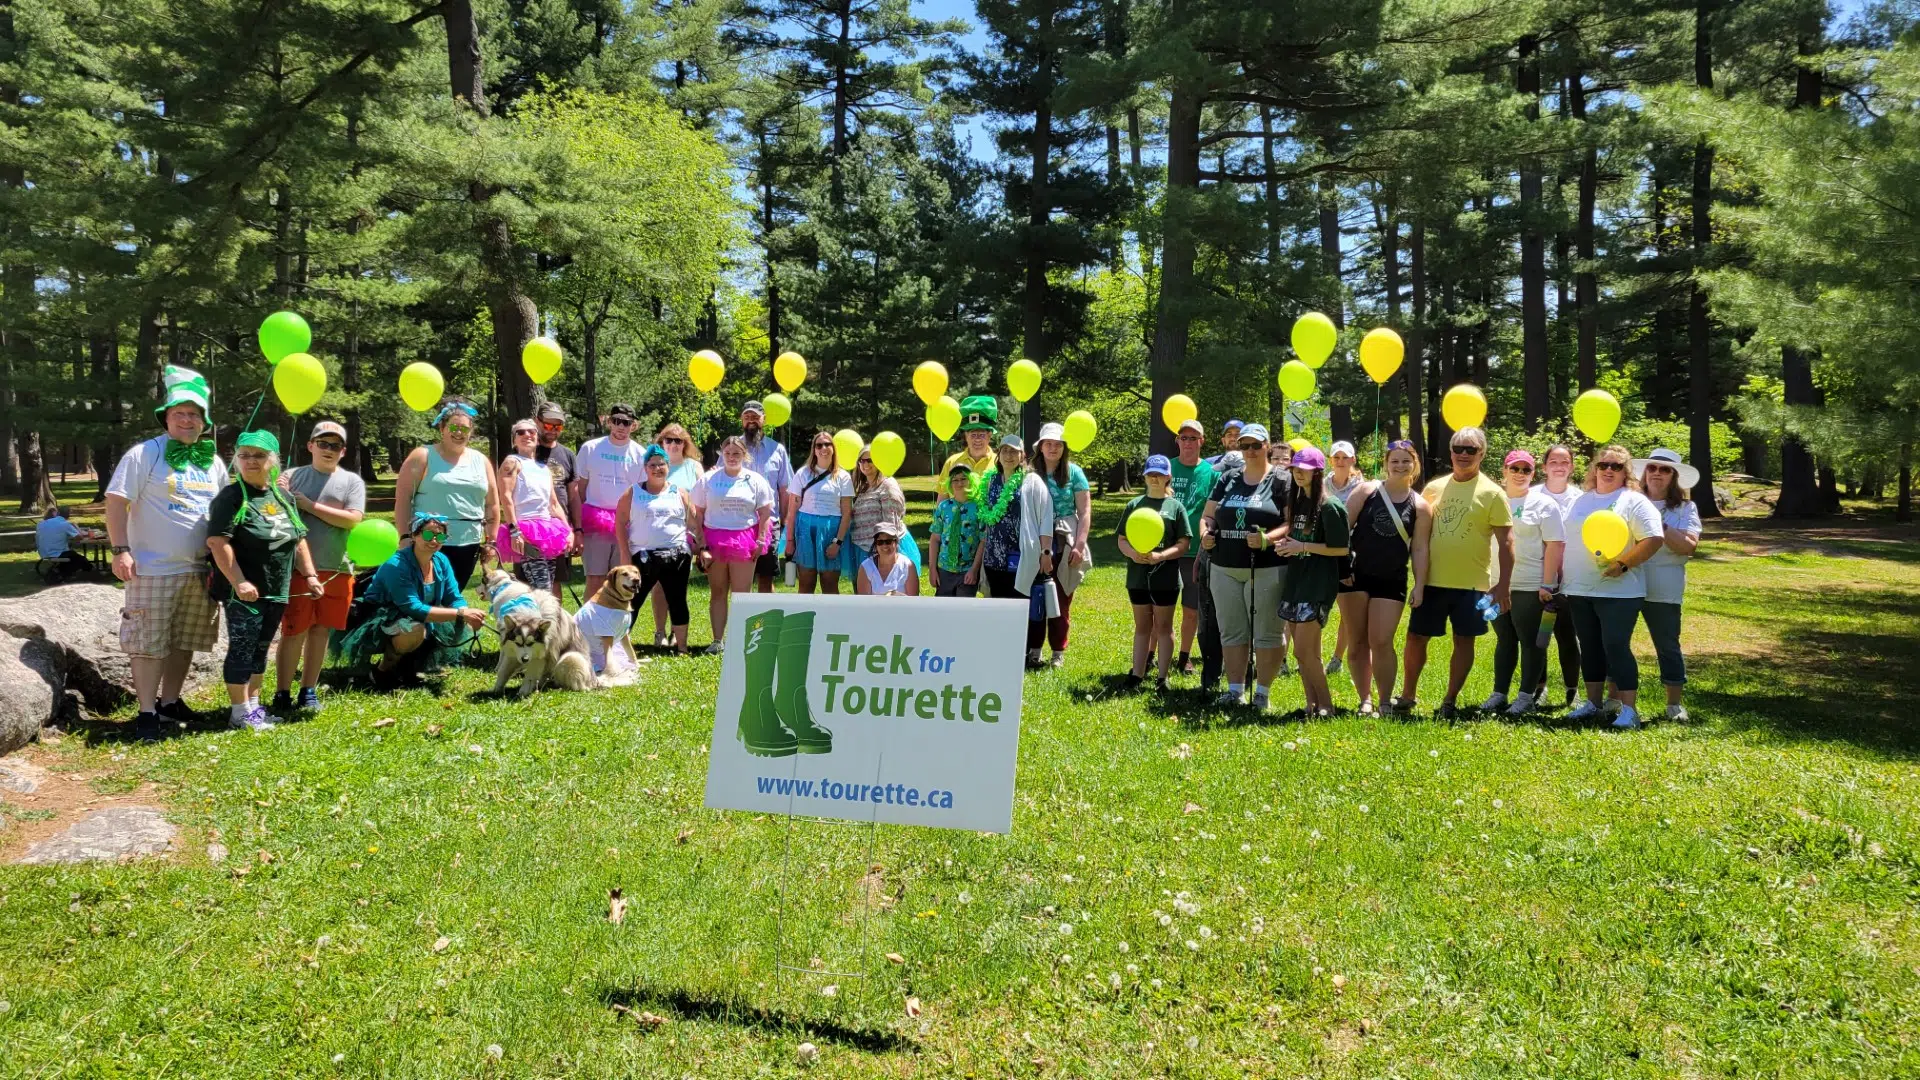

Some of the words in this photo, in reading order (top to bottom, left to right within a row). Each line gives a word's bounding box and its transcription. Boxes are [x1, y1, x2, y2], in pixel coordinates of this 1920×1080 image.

[826, 633, 915, 675] Trek
[919, 649, 956, 674] for
[821, 674, 1002, 723] Tourette
[757, 776, 953, 809] www.tourette.ca
